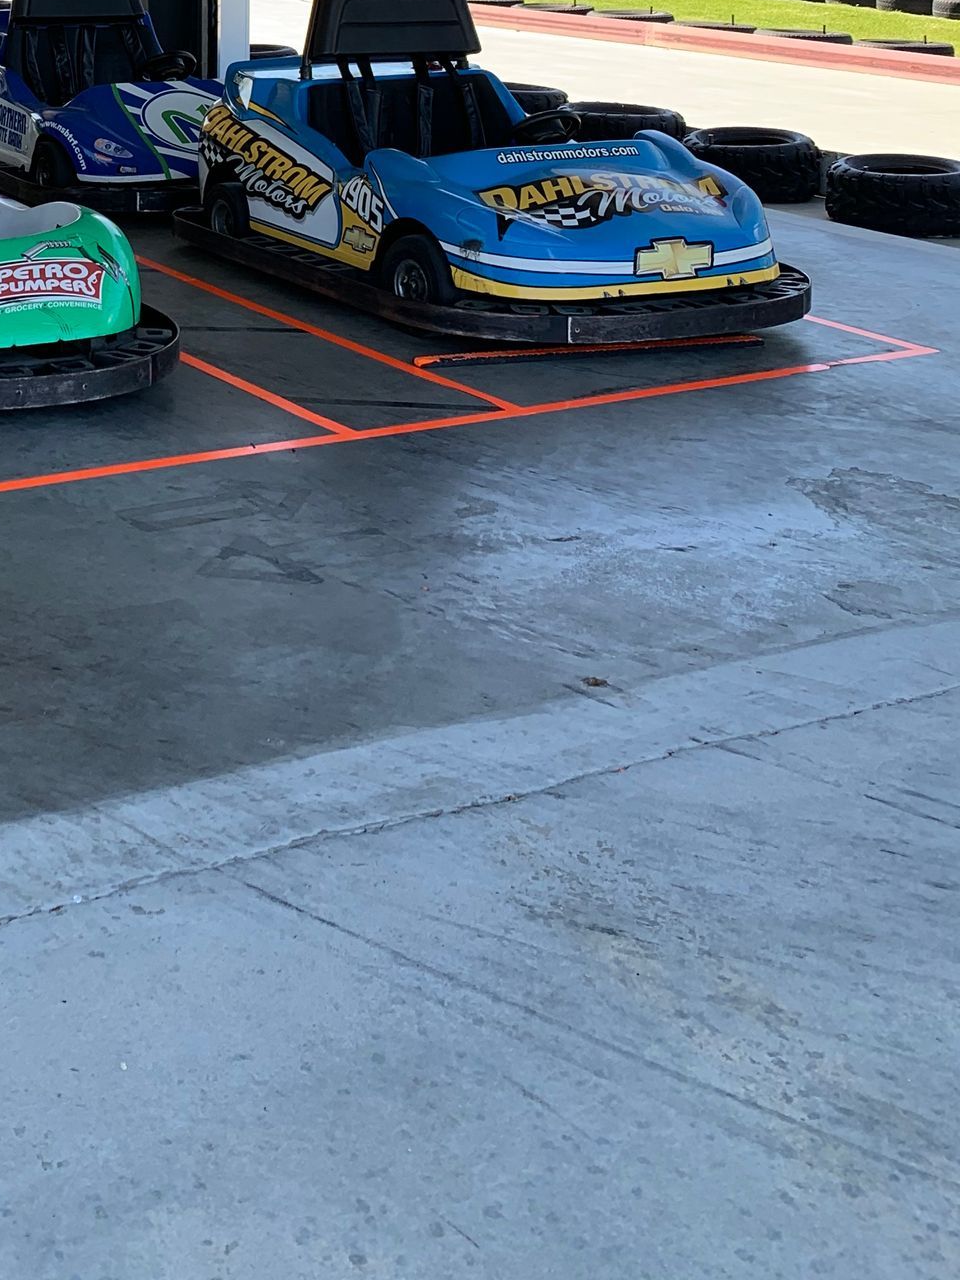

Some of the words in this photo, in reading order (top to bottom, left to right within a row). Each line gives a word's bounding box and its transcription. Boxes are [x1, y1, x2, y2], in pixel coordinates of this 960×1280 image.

[8, 130, 23, 150] BANK
[203, 105, 333, 207] DAHLSTROM
[497, 145, 640, 164] dahlstrommotors.com
[226, 154, 308, 214] Motors
[340, 174, 384, 234] 1905
[4, 302, 44, 314] GROCERY
[47, 300, 103, 311] CONVENIENCE
